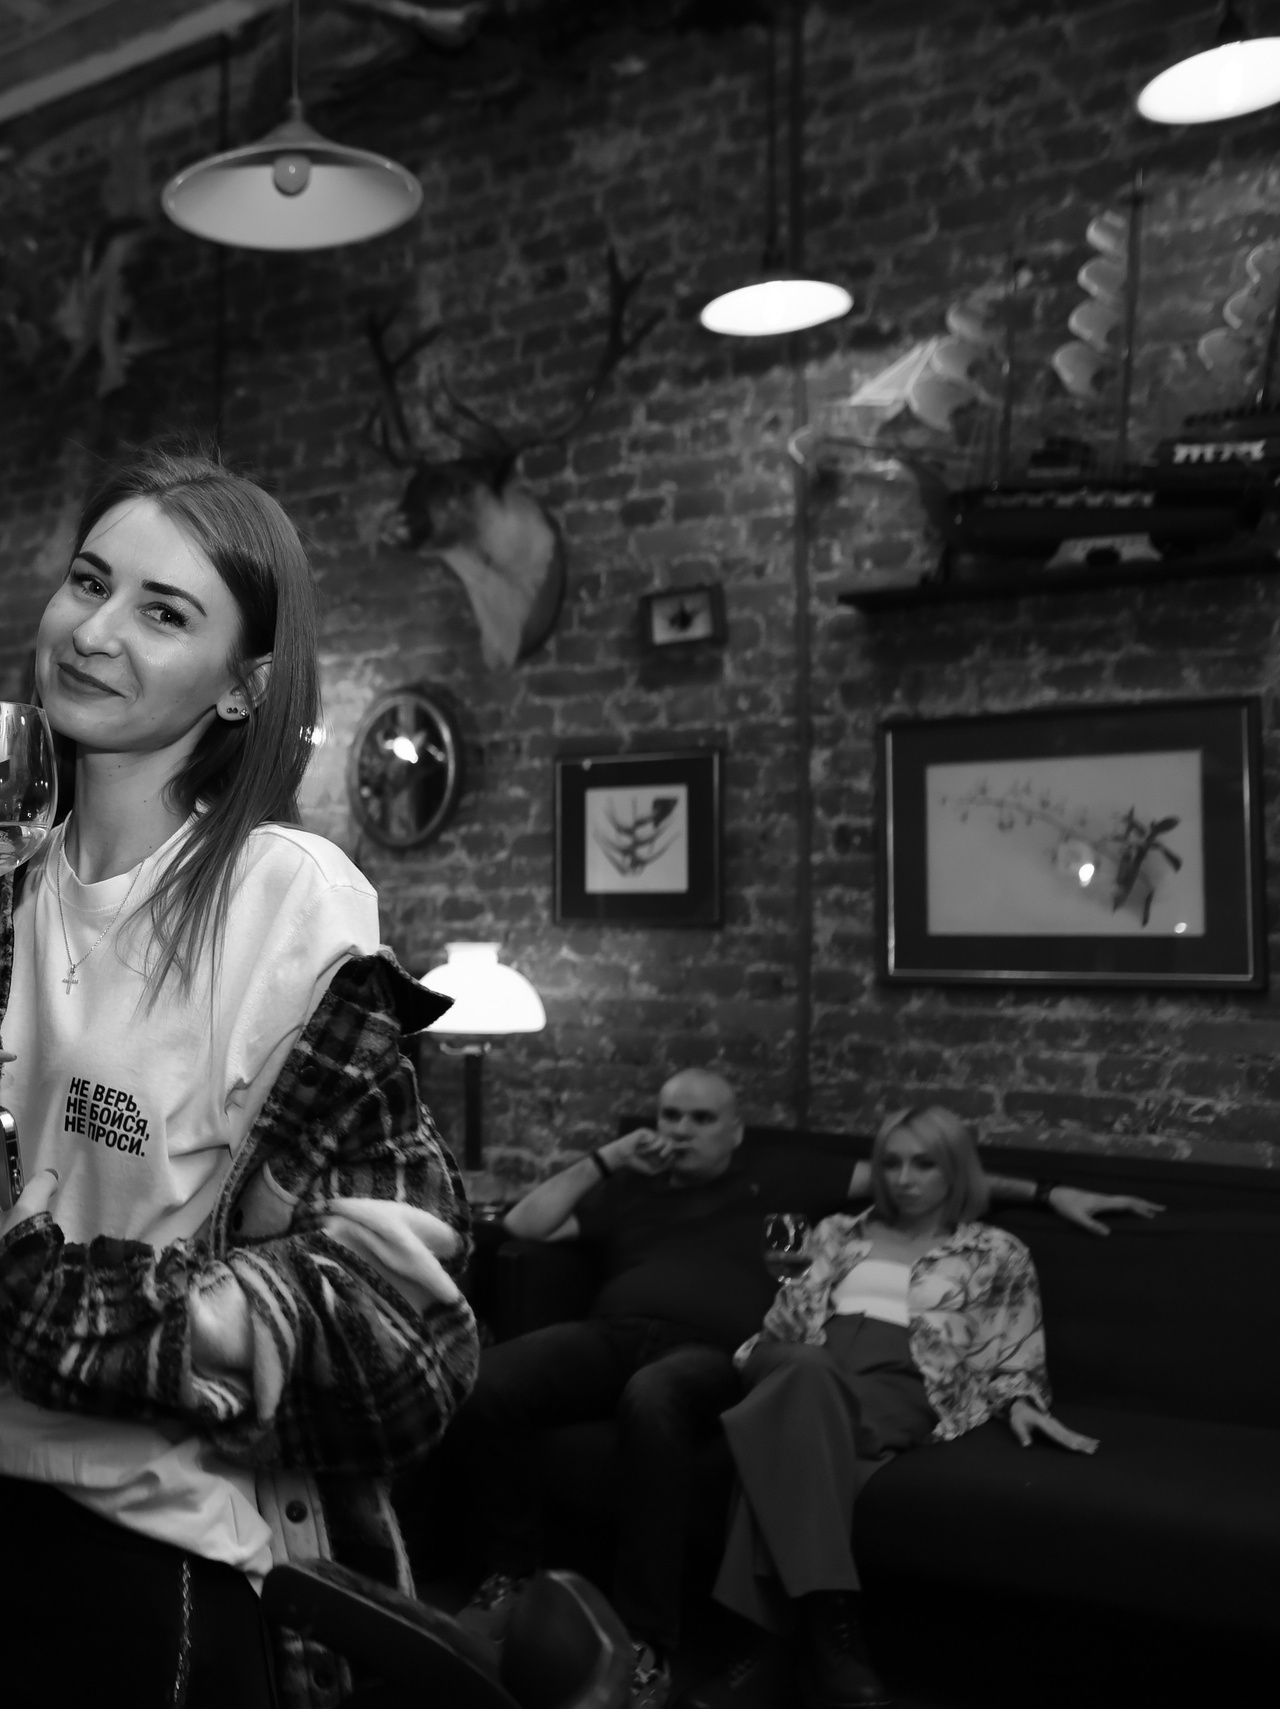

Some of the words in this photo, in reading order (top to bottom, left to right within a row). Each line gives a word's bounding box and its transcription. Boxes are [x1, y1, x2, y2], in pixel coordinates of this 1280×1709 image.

[69, 1077, 90, 1098] НЕ
[92, 1084, 140, 1117] ВЕРЬ,
[64, 1115, 86, 1135] НЕ
[87, 1122, 145, 1156] ПРОСИ.
[65, 1096, 88, 1117] НЕ
[89, 1103, 150, 1141] БОЙСЯ,
